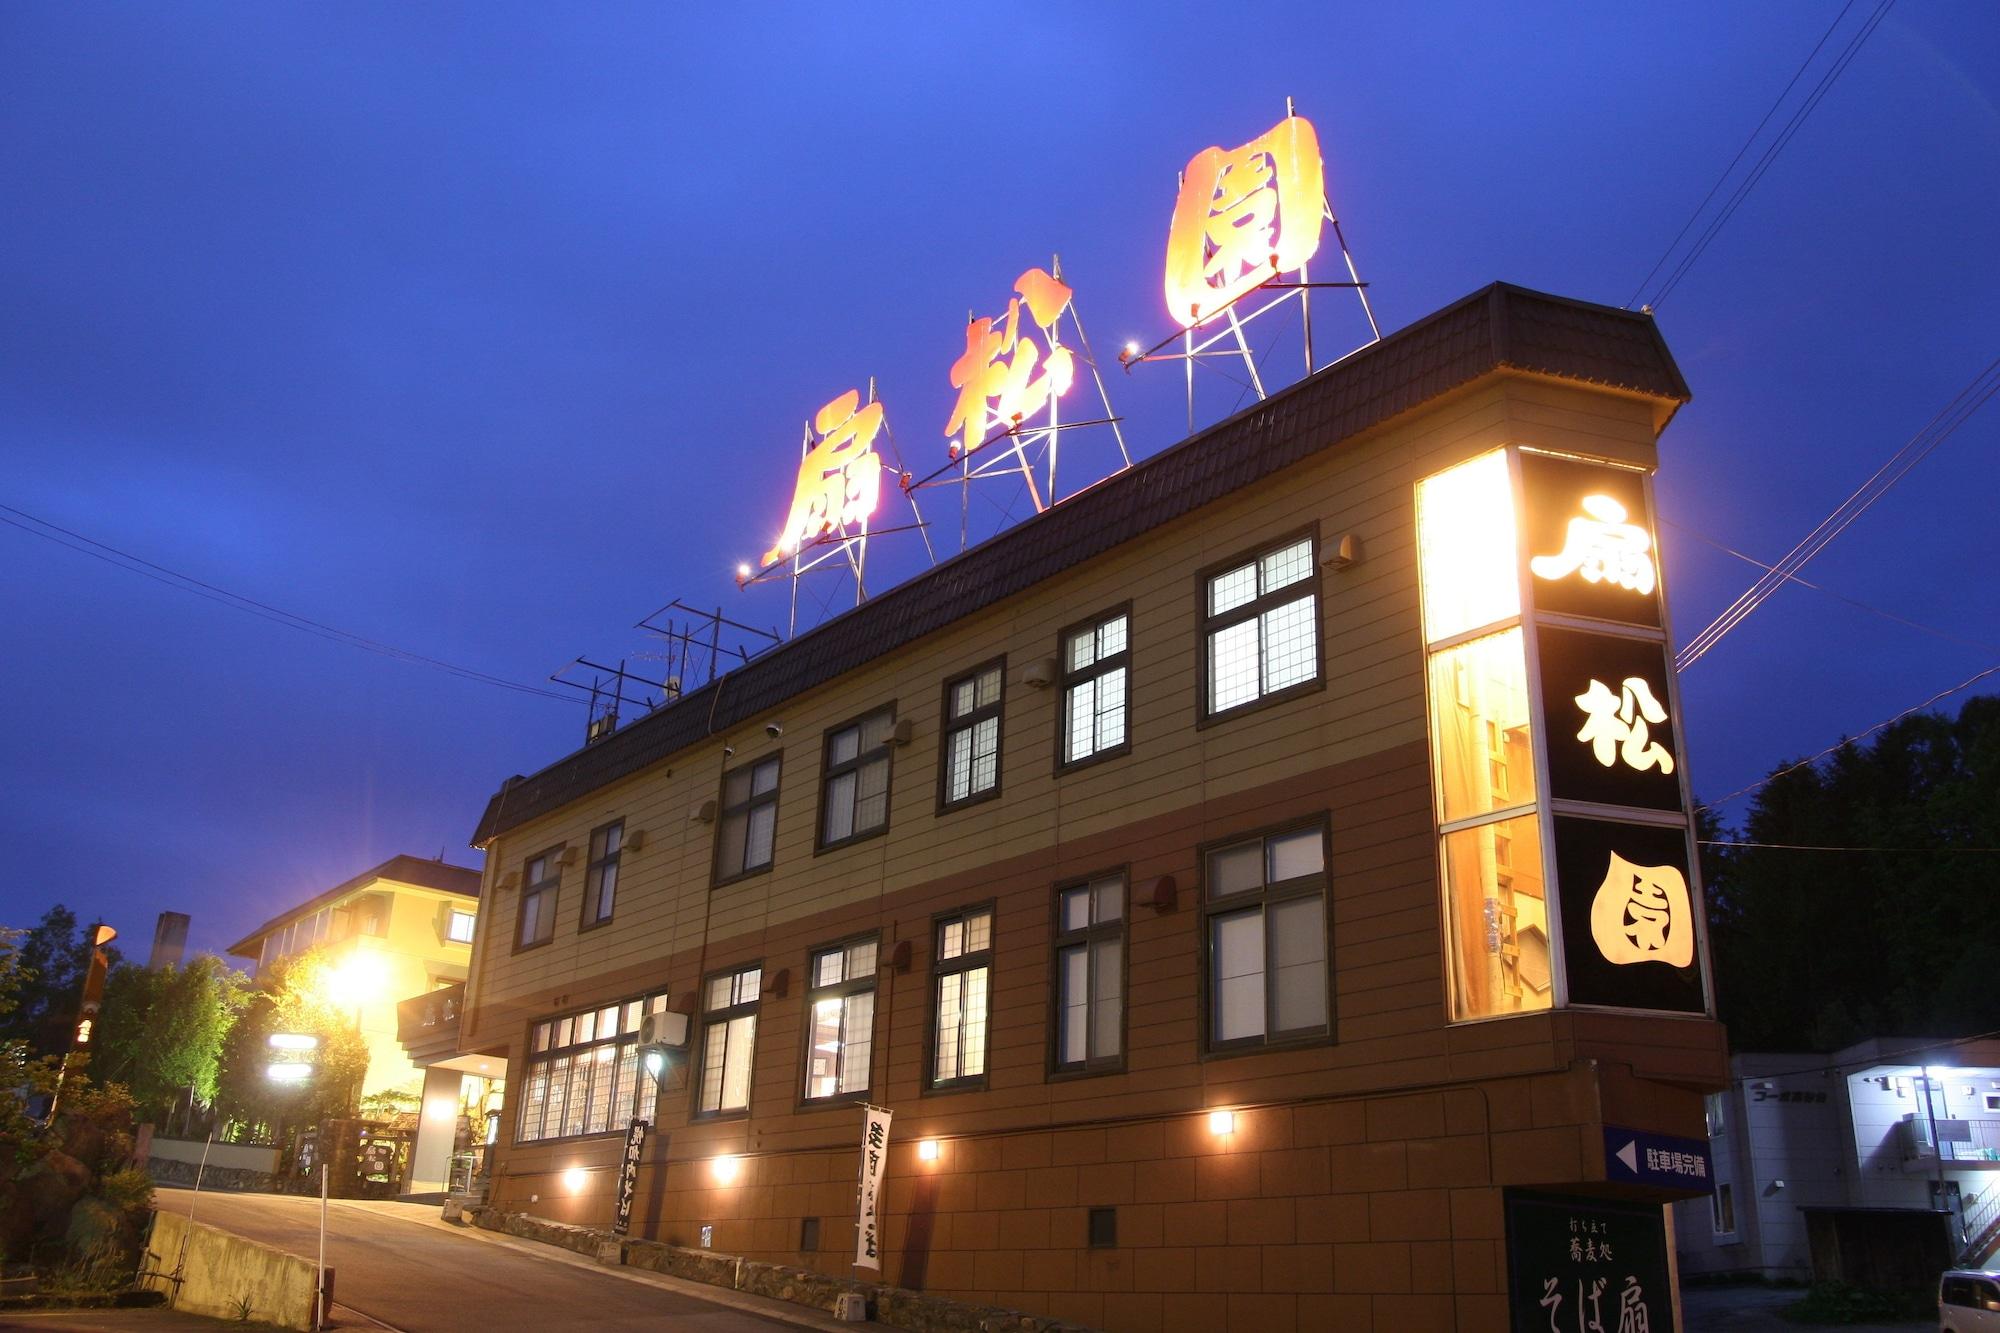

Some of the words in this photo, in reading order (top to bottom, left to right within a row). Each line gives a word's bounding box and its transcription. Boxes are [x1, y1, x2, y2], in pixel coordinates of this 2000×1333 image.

[1531, 494, 1694, 968] 扇松園
[1646, 1148, 1706, 1178] 駐車場完備
[1569, 1236, 1613, 1263] 蕎麦処
[1539, 1274, 1650, 1333] そば扇
